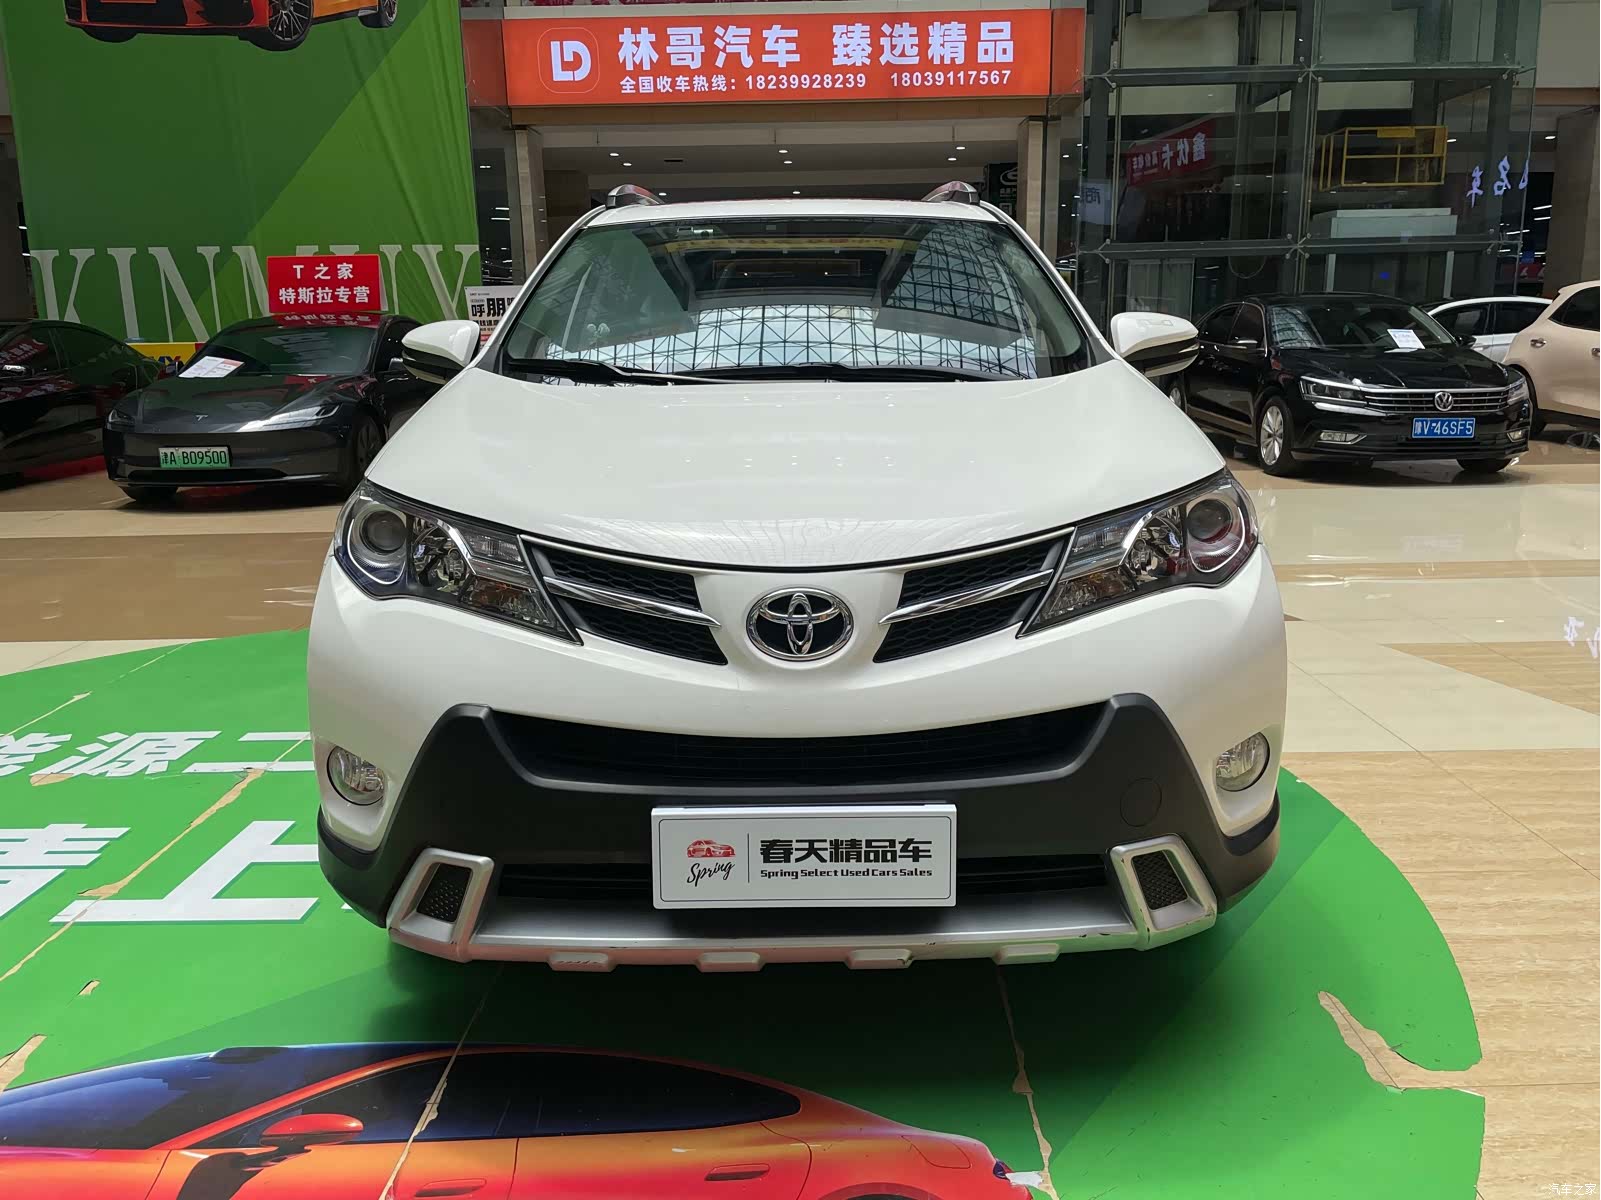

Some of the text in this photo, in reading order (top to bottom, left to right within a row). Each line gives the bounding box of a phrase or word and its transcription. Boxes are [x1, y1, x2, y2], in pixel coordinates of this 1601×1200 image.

[618, 21, 1014, 71] 林哥汽车 臻选精品
[891, 70, 1011, 87] 18039117567
[279, 286, 370, 305] 特斯拉专营
[760, 837, 932, 864] 春天精品车
[687, 861, 736, 887] Spring
[760, 867, 932, 879] Spring Select Used Cars Sales
